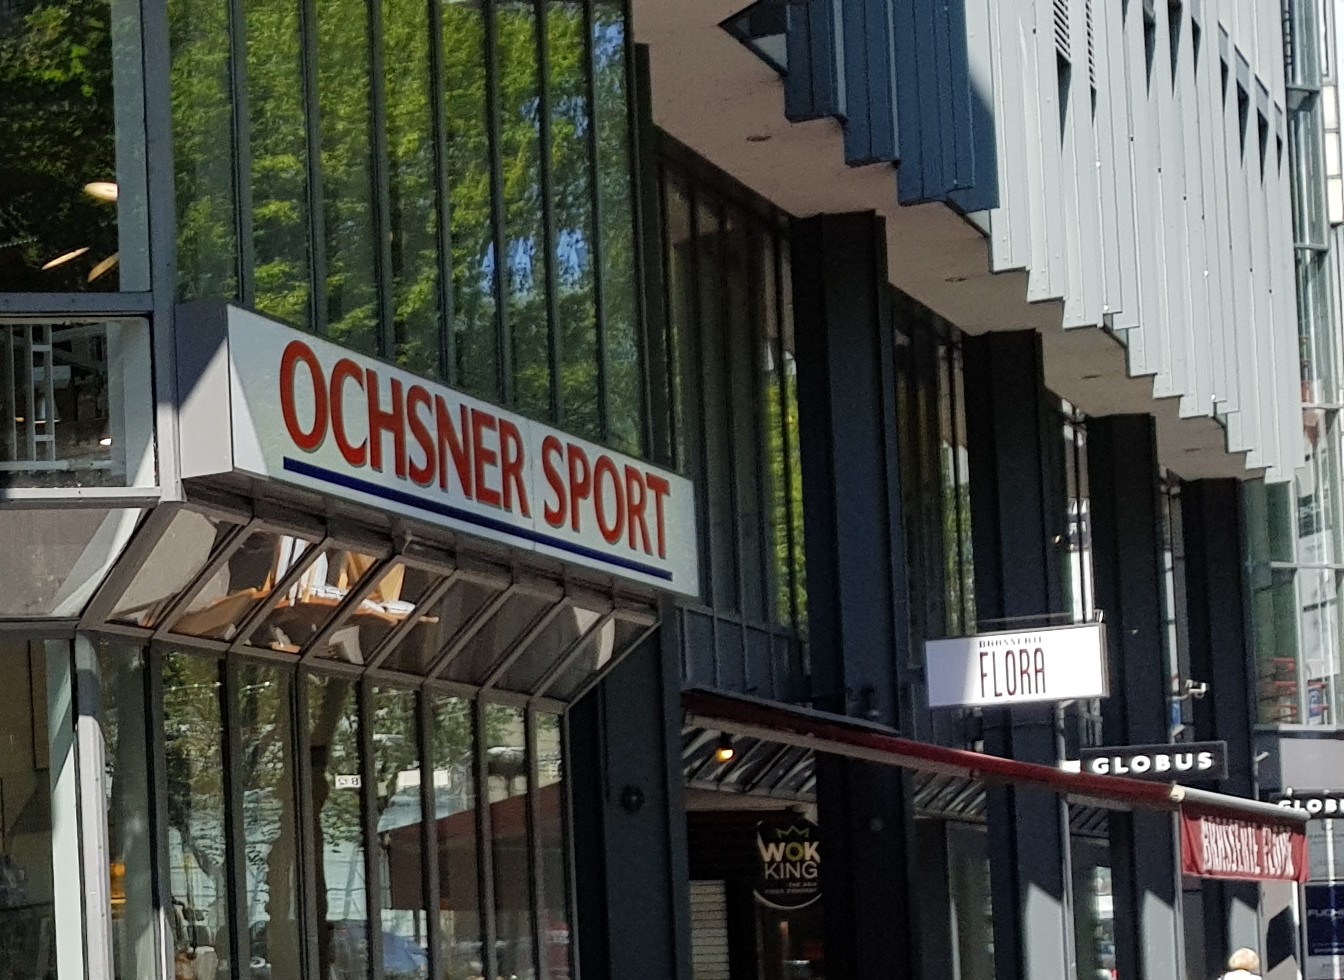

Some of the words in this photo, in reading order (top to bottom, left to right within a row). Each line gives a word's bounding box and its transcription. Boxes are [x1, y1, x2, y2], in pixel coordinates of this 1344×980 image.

[280, 340, 531, 519] OCHSNER
[541, 435, 670, 560] SPORT
[979, 636, 1043, 649] BRASSERIE
[979, 647, 1046, 698] FLORA
[1092, 752, 1214, 775] GLOBUS
[1278, 798, 1344, 815] GLOB
[758, 841, 821, 863] WOK
[765, 861, 818, 879] KING
